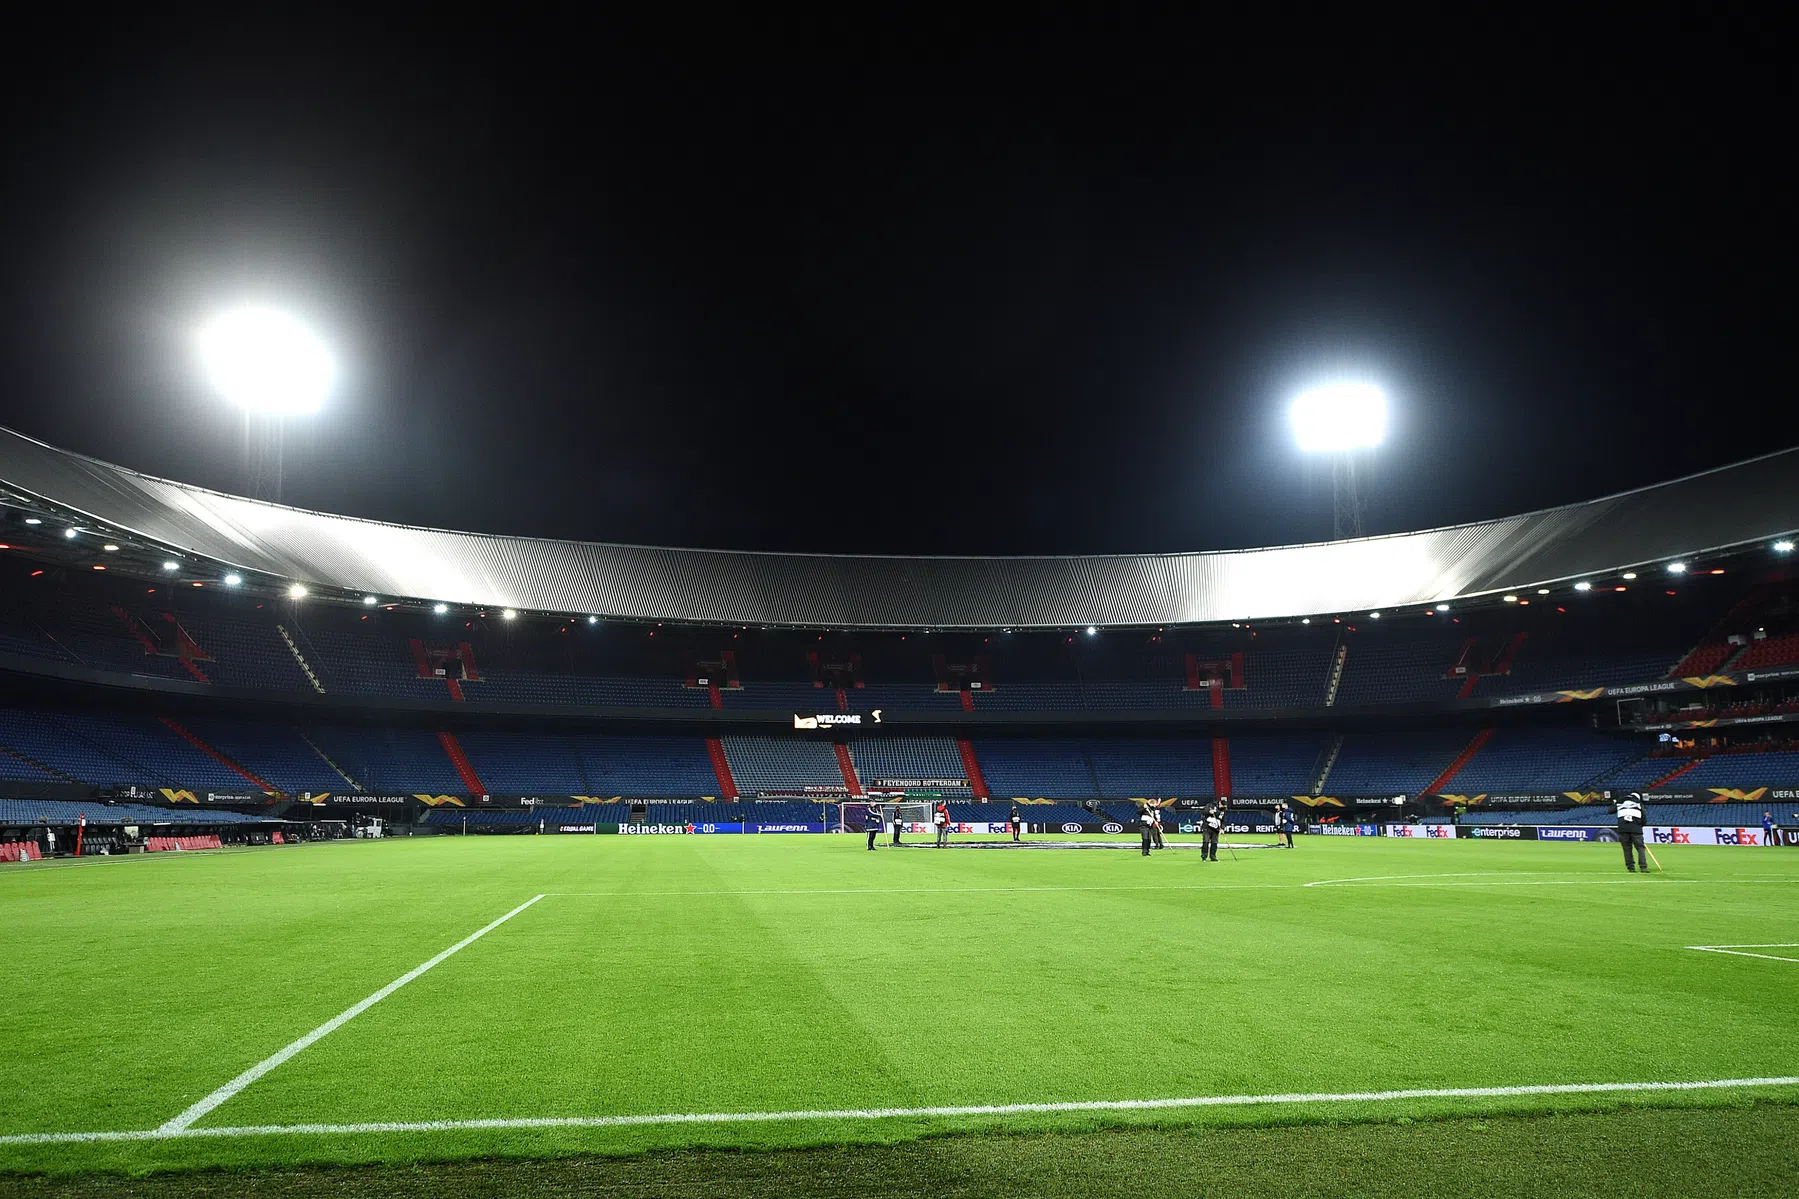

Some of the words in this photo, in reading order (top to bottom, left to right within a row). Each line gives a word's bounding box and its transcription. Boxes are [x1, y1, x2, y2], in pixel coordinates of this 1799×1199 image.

[1608, 688, 1624, 696] UEFA
[1625, 685, 1649, 694] EUROPA
[1650, 682, 1675, 691] LEAGUE
[816, 715, 861, 724] WELCOME
[520, 797, 544, 805] FedEx
[618, 823, 683, 834] Heineken
[1064, 824, 1081, 833] KIA
[1105, 824, 1122, 833] KIA
[1322, 824, 1355, 836] Heineken
[1393, 826, 1413, 838] FedEx
[1426, 826, 1448, 838] FedEx
[1473, 827, 1520, 838] enterprise
[1652, 828, 1691, 843] FedEx
[1715, 828, 1758, 845] FedEx
